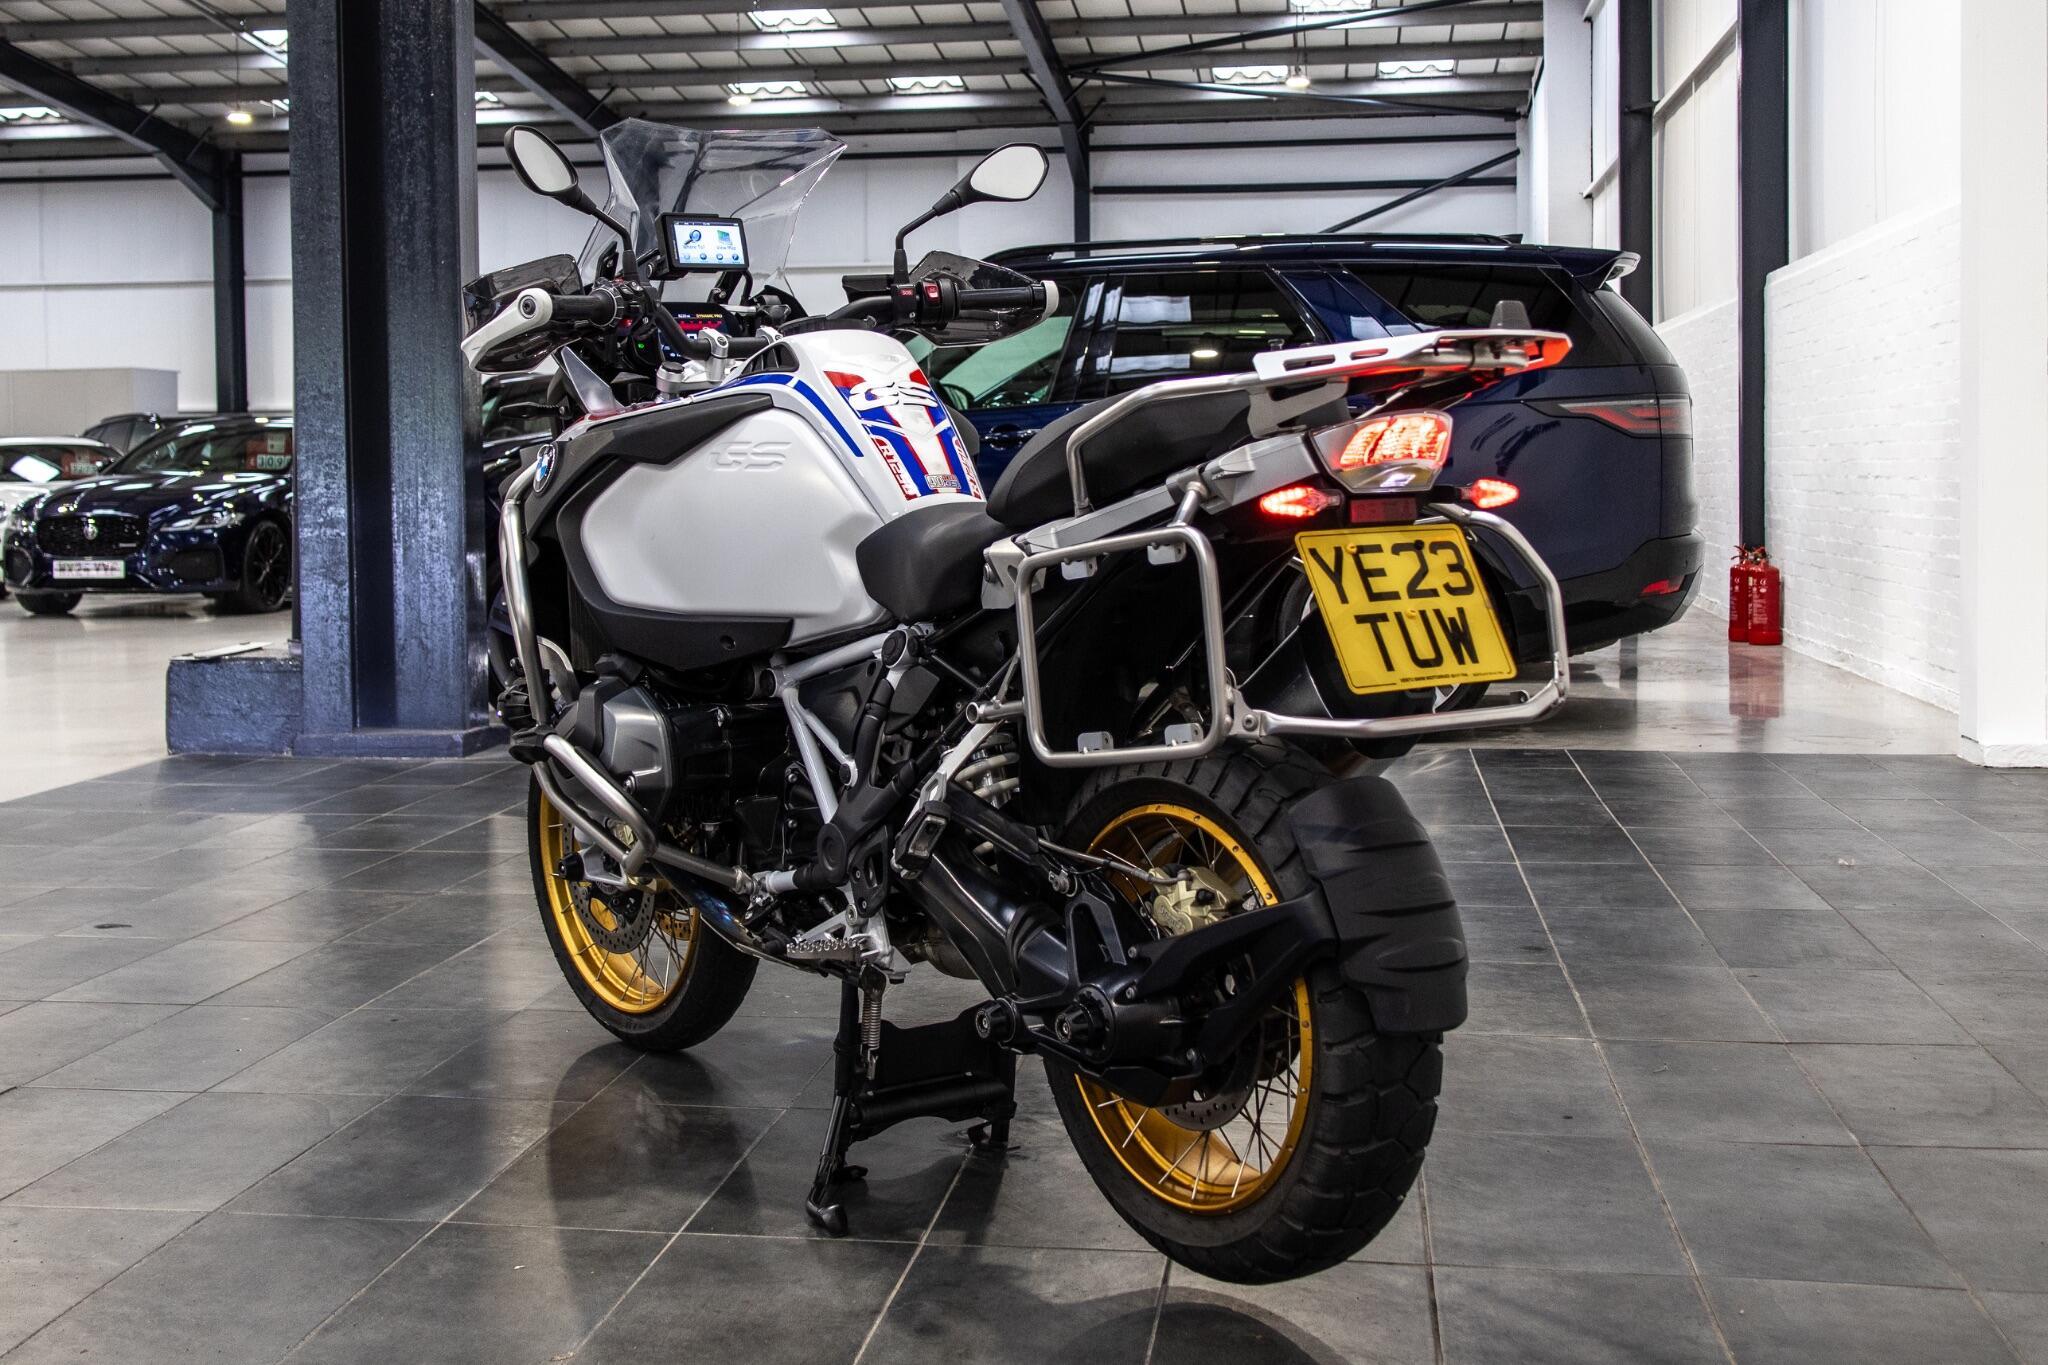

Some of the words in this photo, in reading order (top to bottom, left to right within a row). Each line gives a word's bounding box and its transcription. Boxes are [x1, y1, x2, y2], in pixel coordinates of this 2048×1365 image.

[848, 380, 938, 411] GS
[708, 441, 791, 471] GS
[1309, 540, 1474, 604] YE23
[1355, 607, 1479, 672] TUW
